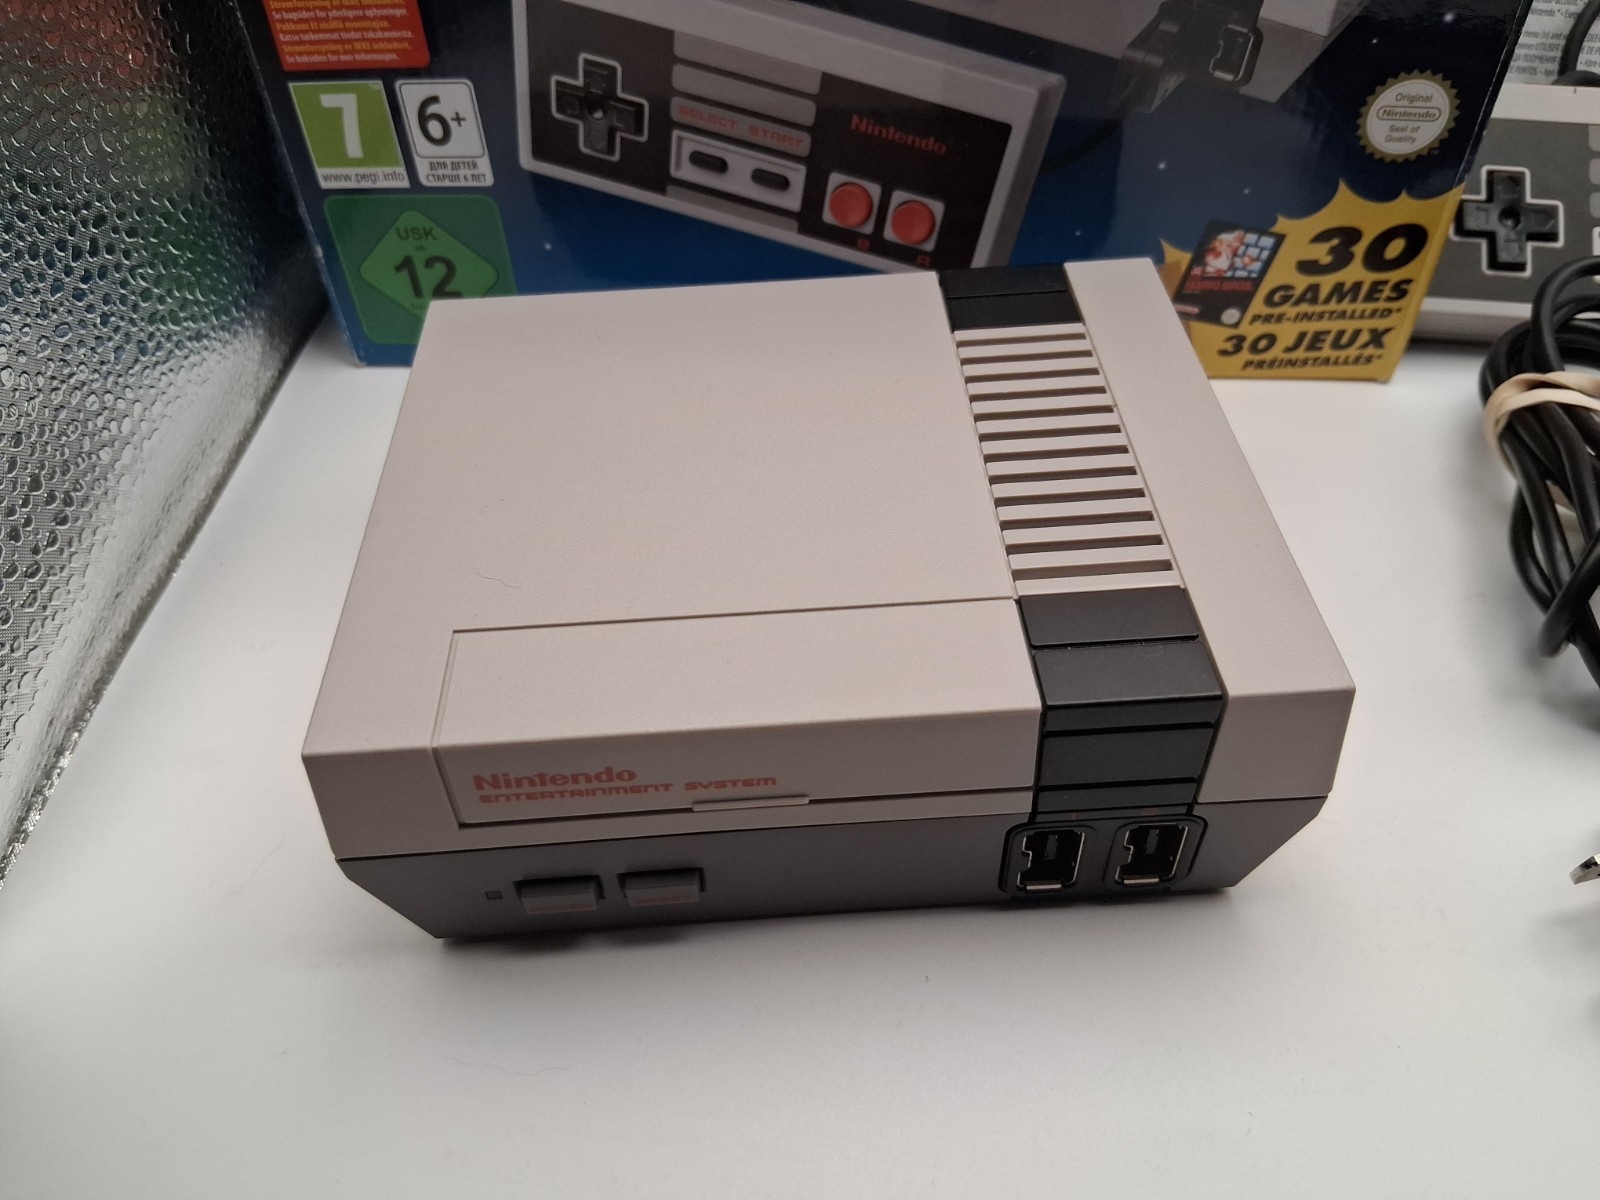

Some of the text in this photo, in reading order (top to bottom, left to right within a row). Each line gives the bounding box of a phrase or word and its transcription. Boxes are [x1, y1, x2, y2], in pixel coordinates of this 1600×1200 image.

[1395, 92, 1434, 104] Original
[320, 93, 364, 159] 7
[418, 95, 466, 146] 6+
[676, 105, 804, 148] SELECT START
[1381, 108, 1436, 120] Nintendo
[850, 114, 946, 154] Nintendo
[1384, 135, 1418, 144] Quality
[1388, 124, 1420, 133] Seal of
[322, 171, 405, 184] www.pegi.info
[426, 174, 461, 183] СТАРШЕ
[471, 174, 487, 183] ЛЕТ
[430, 160, 479, 171] ДЛЯ ДЕТЕЙ
[396, 227, 437, 241] USK
[1296, 223, 1428, 276] 30
[394, 255, 463, 300] 12
[1263, 278, 1414, 308] GAMES
[1217, 326, 1395, 357] 30 JEUX
[473, 766, 637, 791] Nintendo
[478, 777, 776, 804] ENTERTAINMENT SYSTEM
